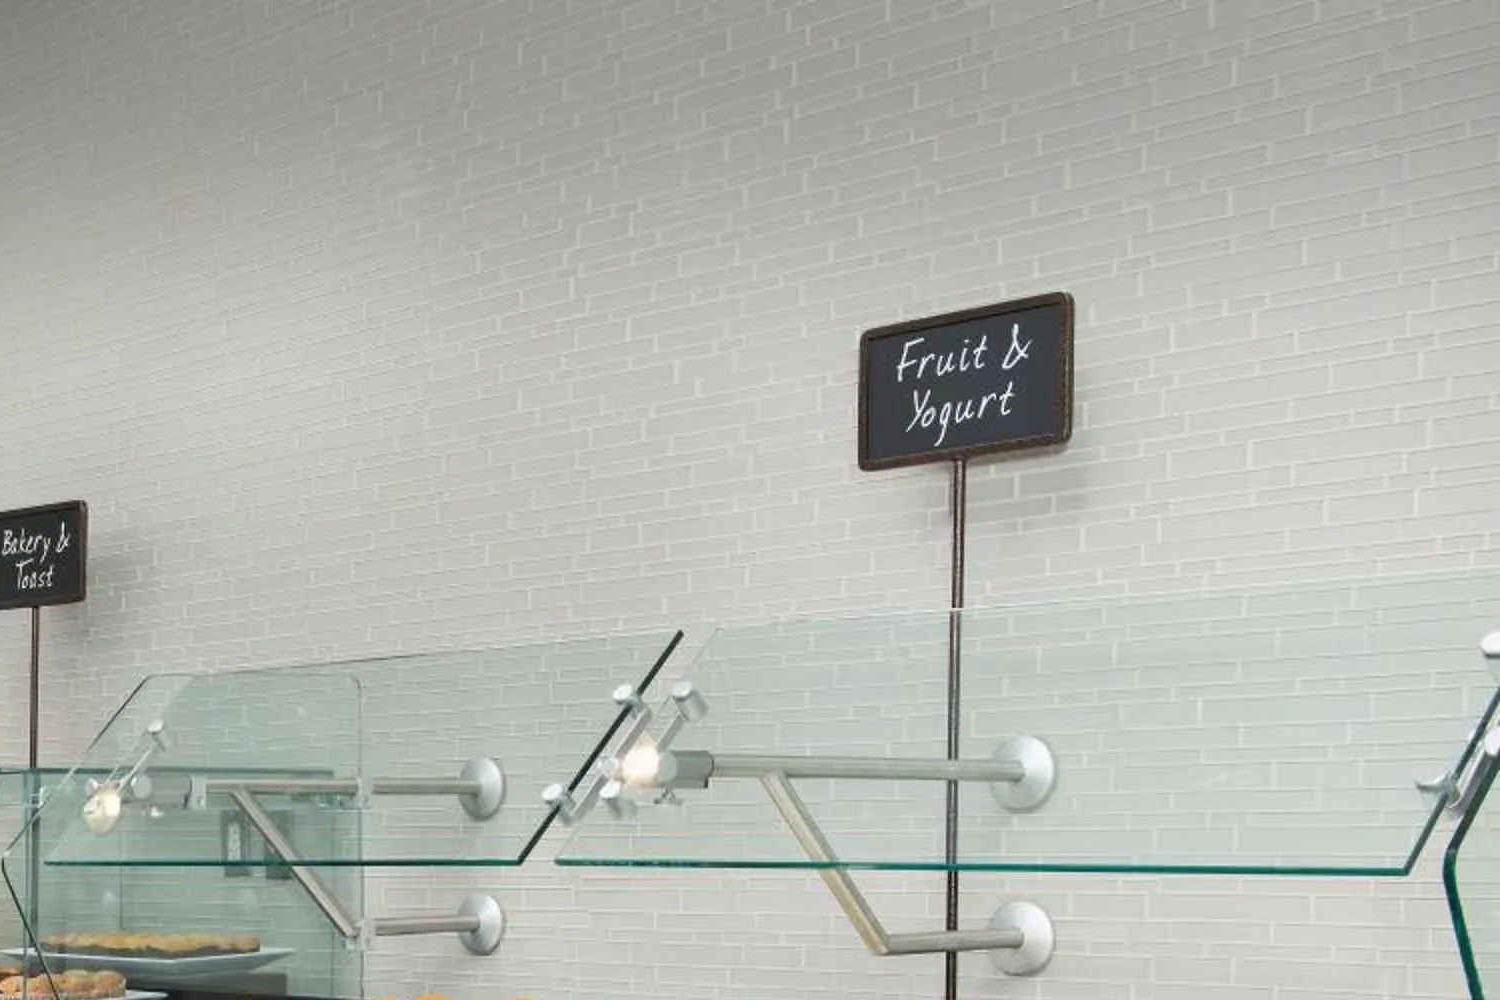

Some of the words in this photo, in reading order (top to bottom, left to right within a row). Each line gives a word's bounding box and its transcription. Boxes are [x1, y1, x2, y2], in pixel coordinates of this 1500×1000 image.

[896, 334, 987, 382] Fruit
[1001, 323, 1033, 370] &
[905, 381, 1014, 447] Yogurt
[1, 527, 51, 563] Bakery
[55, 520, 71, 553] &
[15, 558, 54, 589] Toast
